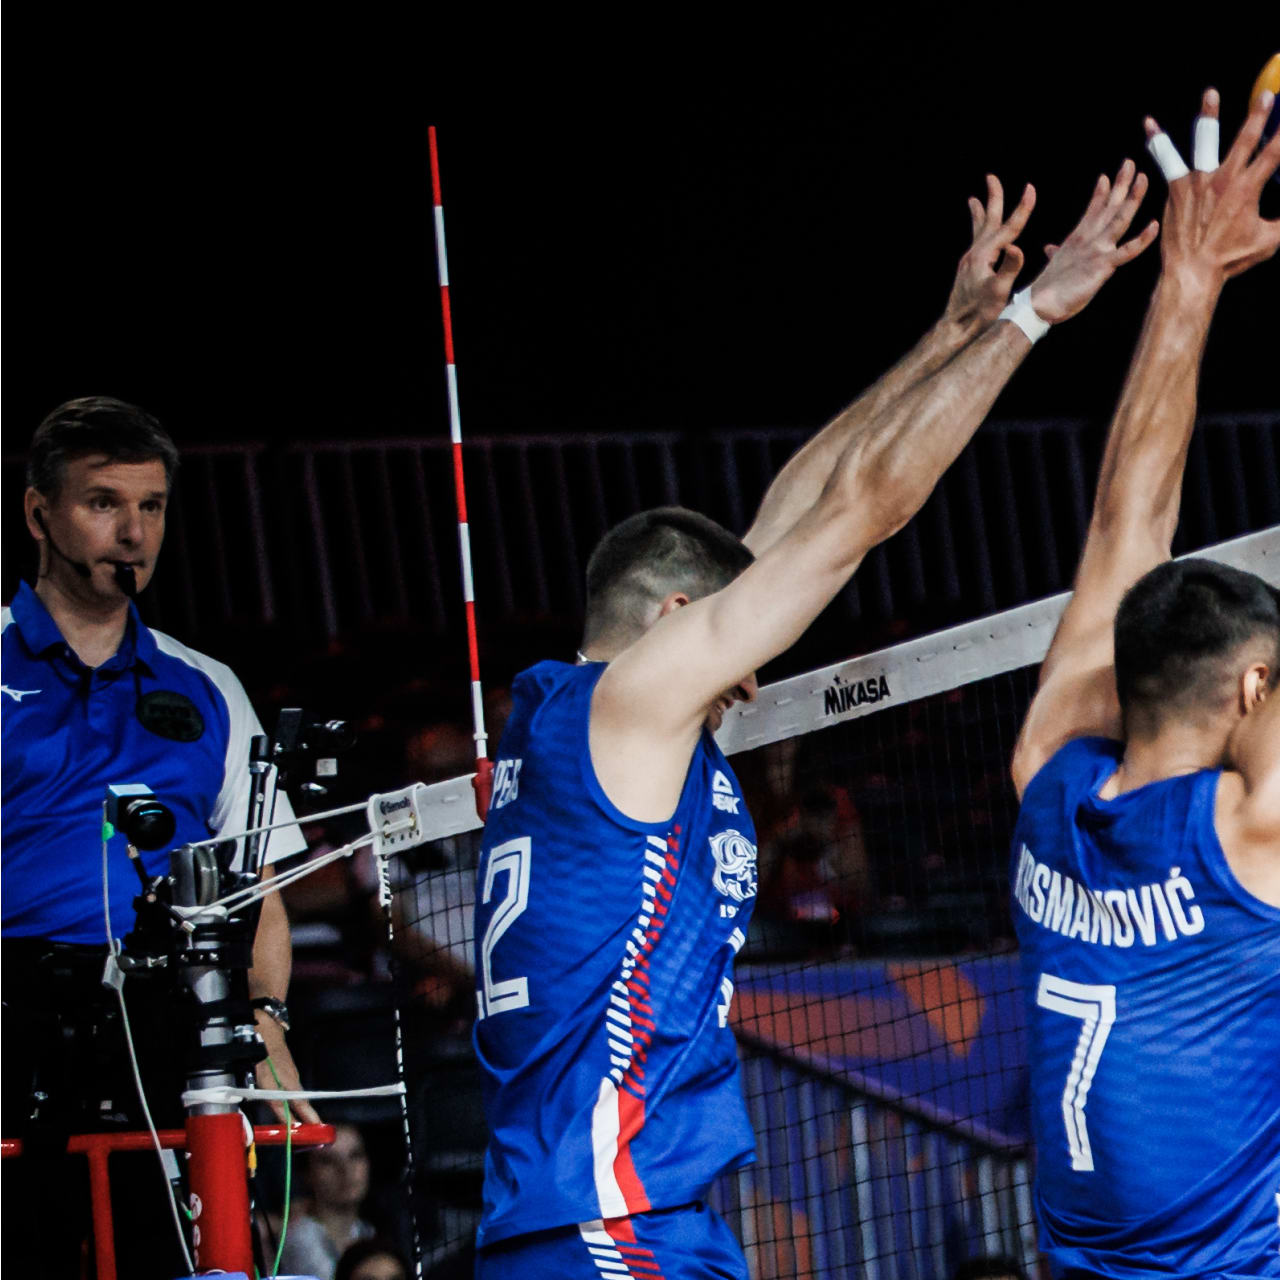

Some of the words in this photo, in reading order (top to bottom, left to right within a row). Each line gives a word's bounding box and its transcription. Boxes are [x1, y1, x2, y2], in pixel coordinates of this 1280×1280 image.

[824, 675, 891, 716] MIKASA
[477, 836, 531, 1021] 2
[1037, 972, 1117, 1172] 7
